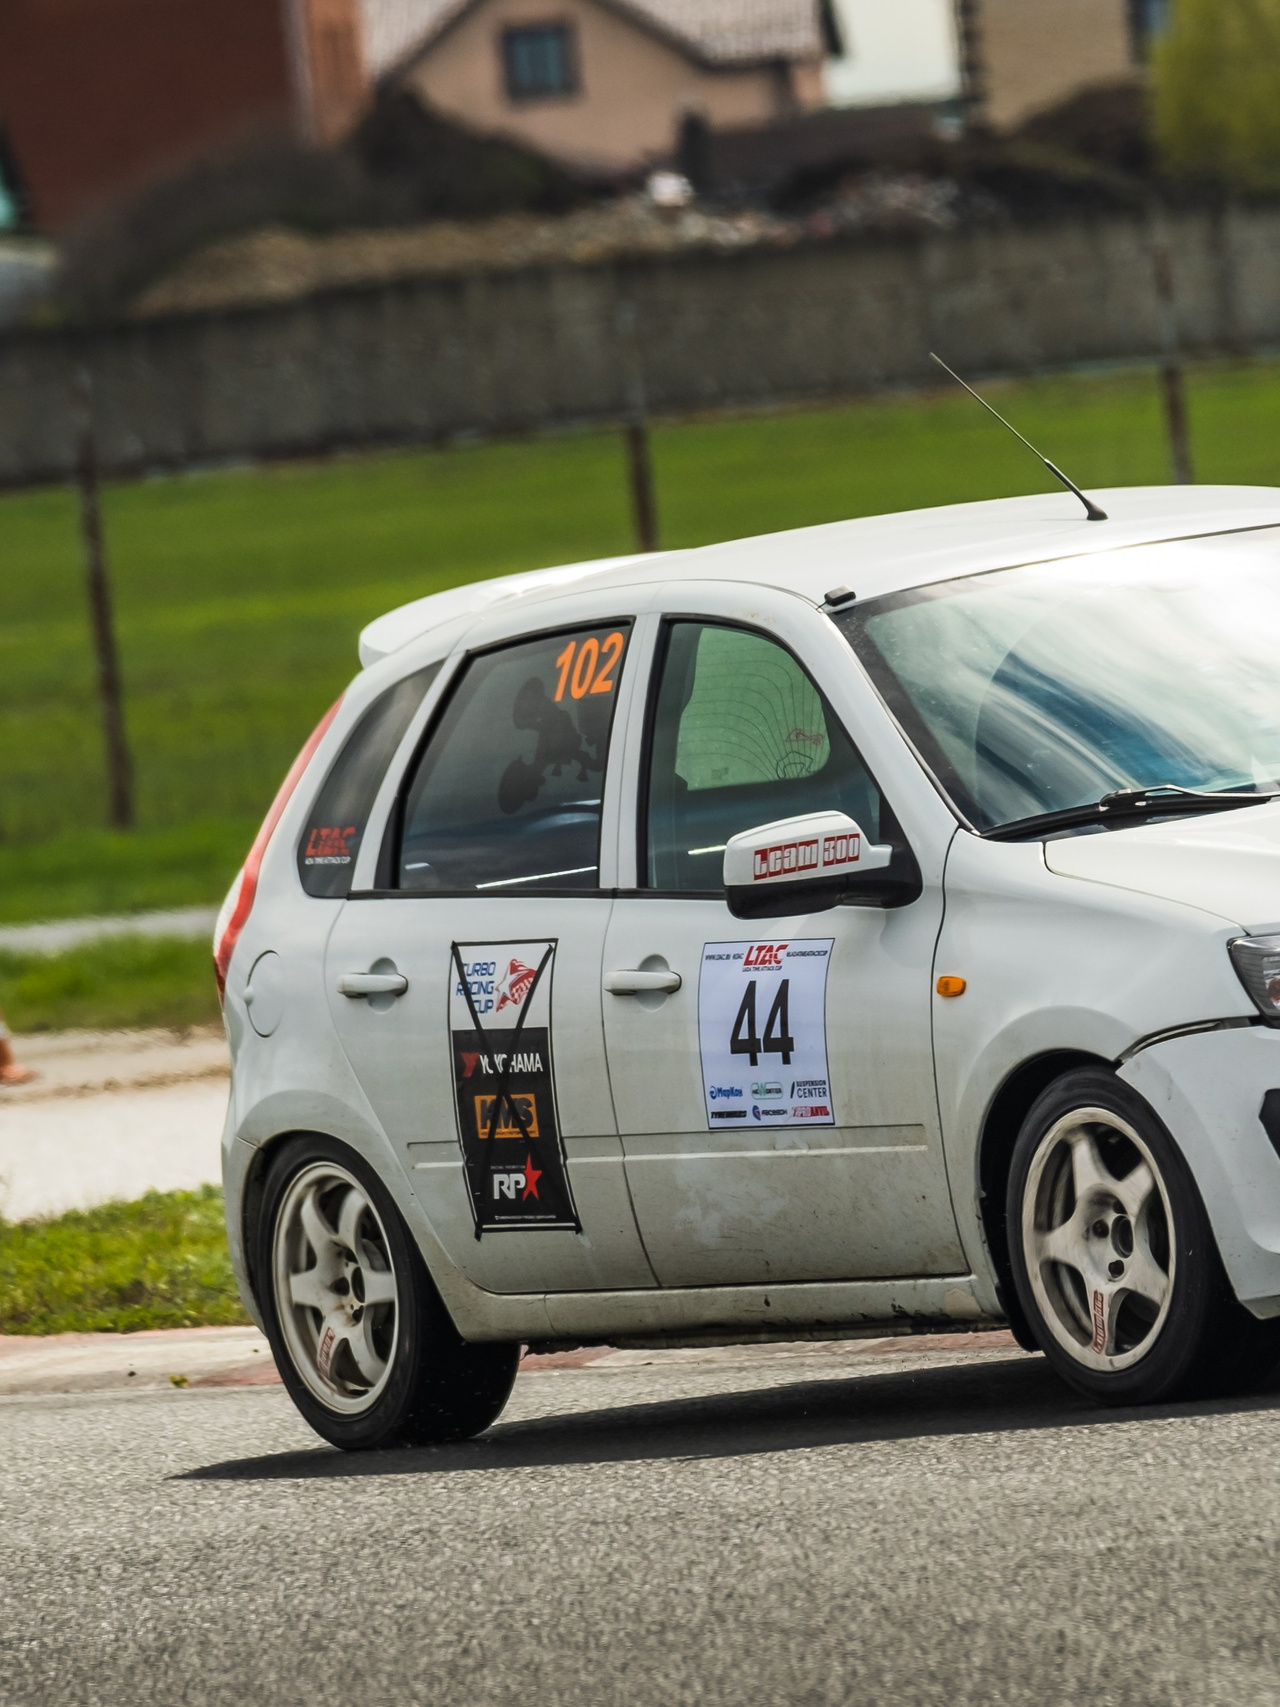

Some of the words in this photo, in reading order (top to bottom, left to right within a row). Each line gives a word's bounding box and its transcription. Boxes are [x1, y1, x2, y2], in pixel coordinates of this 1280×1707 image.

[554, 632, 625, 702] 102
[823, 835, 860, 864] 300
[743, 944, 789, 966] LTAC
[730, 979, 794, 1066] 44
[797, 1087, 827, 1098] CENTER
